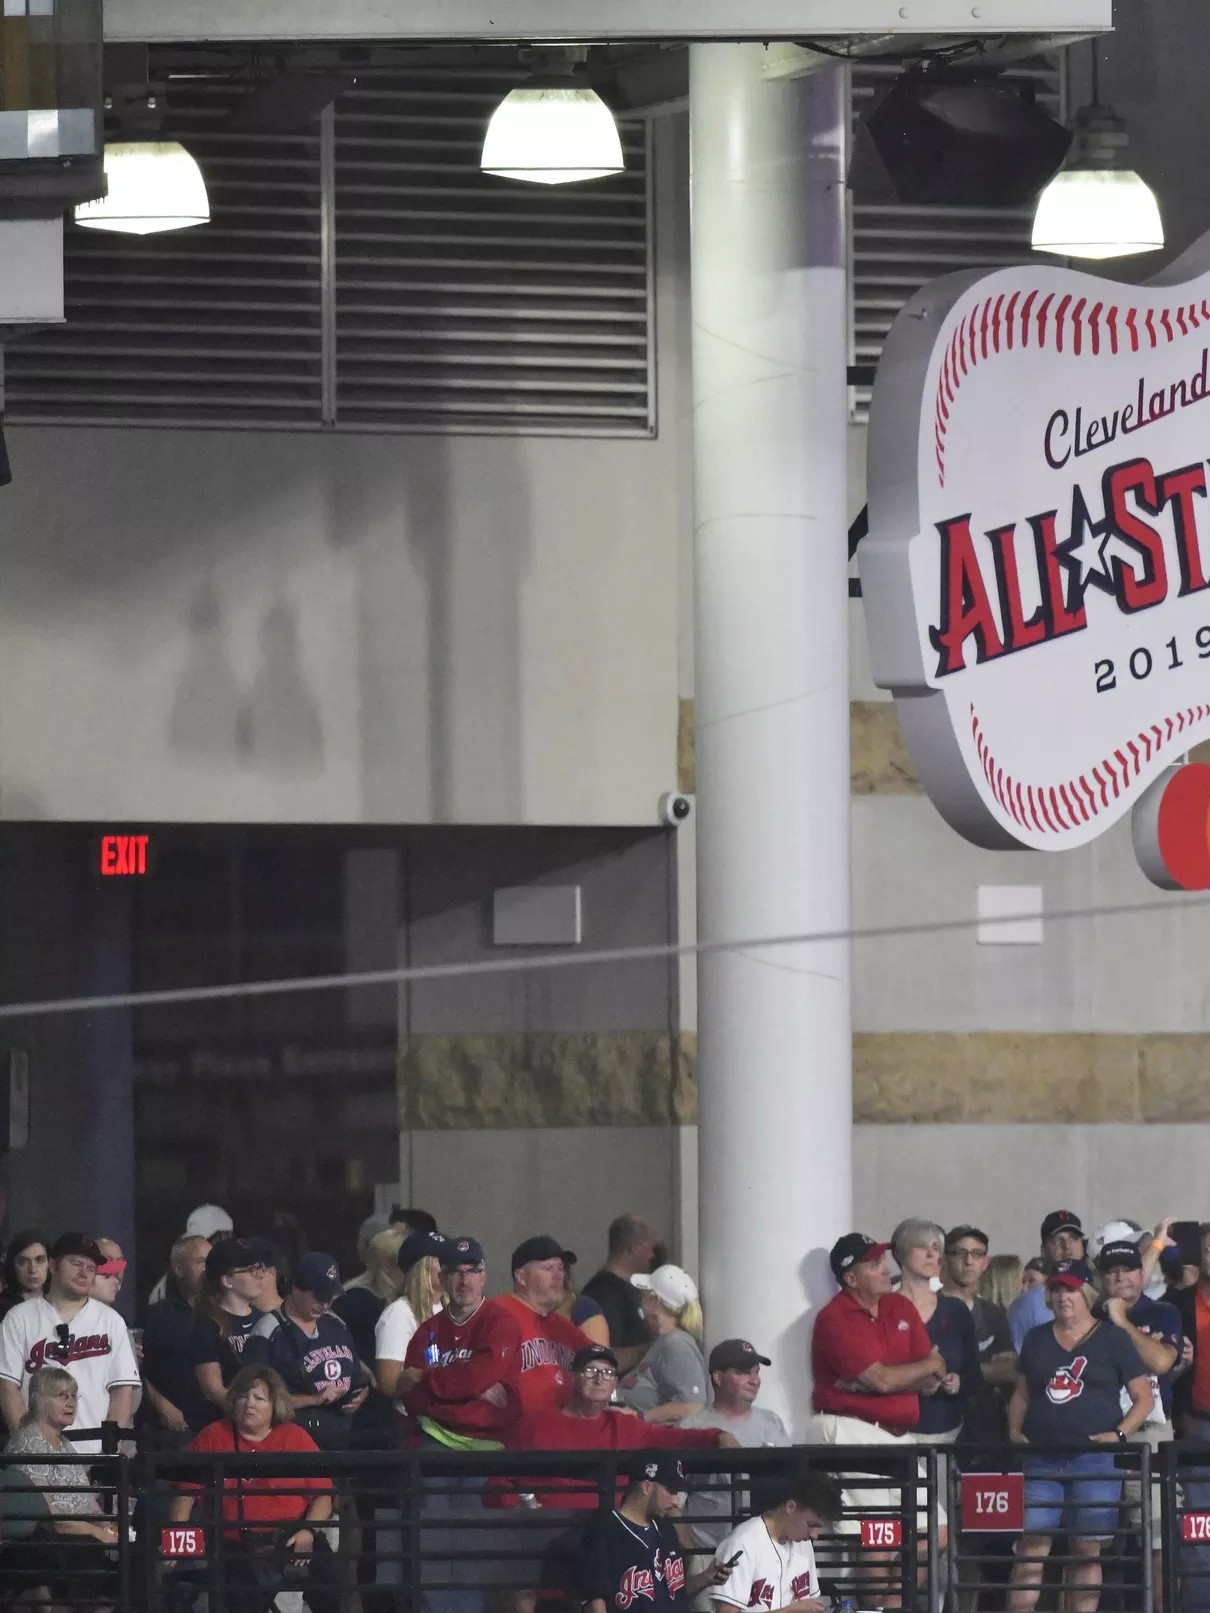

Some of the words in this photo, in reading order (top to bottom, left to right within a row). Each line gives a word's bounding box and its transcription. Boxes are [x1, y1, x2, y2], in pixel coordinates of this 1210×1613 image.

[928, 509, 1088, 678] ALL
[101, 835, 149, 875] EXIT
[25, 1333, 111, 1374] Inians
[976, 1491, 1009, 1513] 176
[169, 1531, 196, 1553] 175
[868, 1523, 894, 1545] 175
[615, 1557, 685, 1610] Inia
